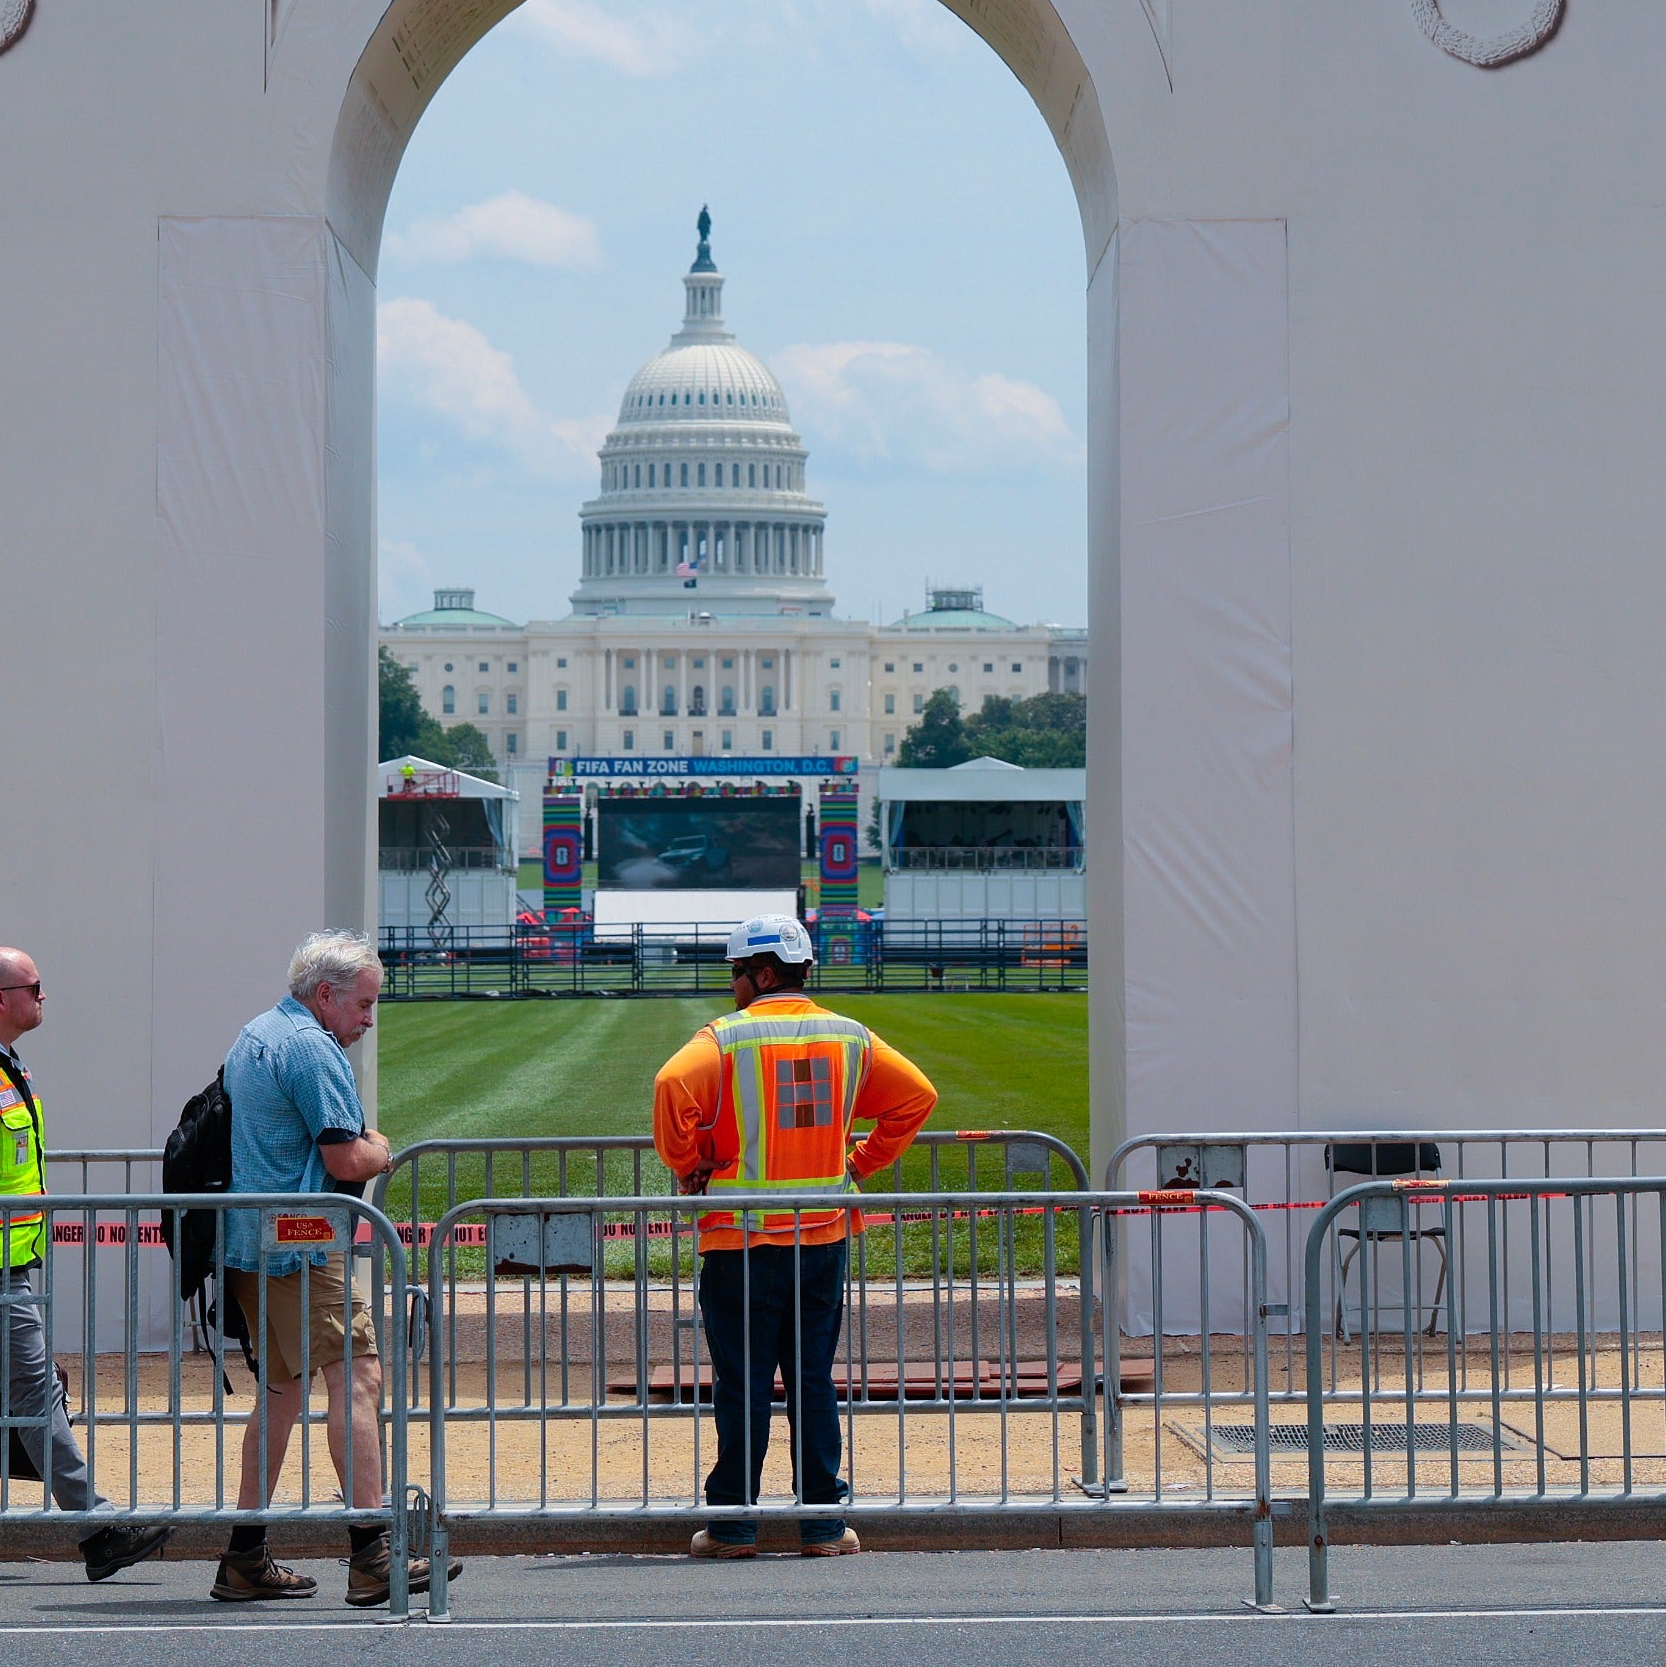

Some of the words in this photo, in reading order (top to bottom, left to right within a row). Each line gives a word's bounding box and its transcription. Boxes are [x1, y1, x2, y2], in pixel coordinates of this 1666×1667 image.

[576, 761, 609, 773] FIFA
[613, 761, 644, 773] FAN
[647, 761, 689, 773] ZONE
[694, 760, 798, 773] WASHINGTON,
[802, 760, 830, 773] D.C.
[1148, 1192, 1184, 1200] FENCE
[296, 1222, 313, 1230] USA
[287, 1228, 322, 1236] FENCE
